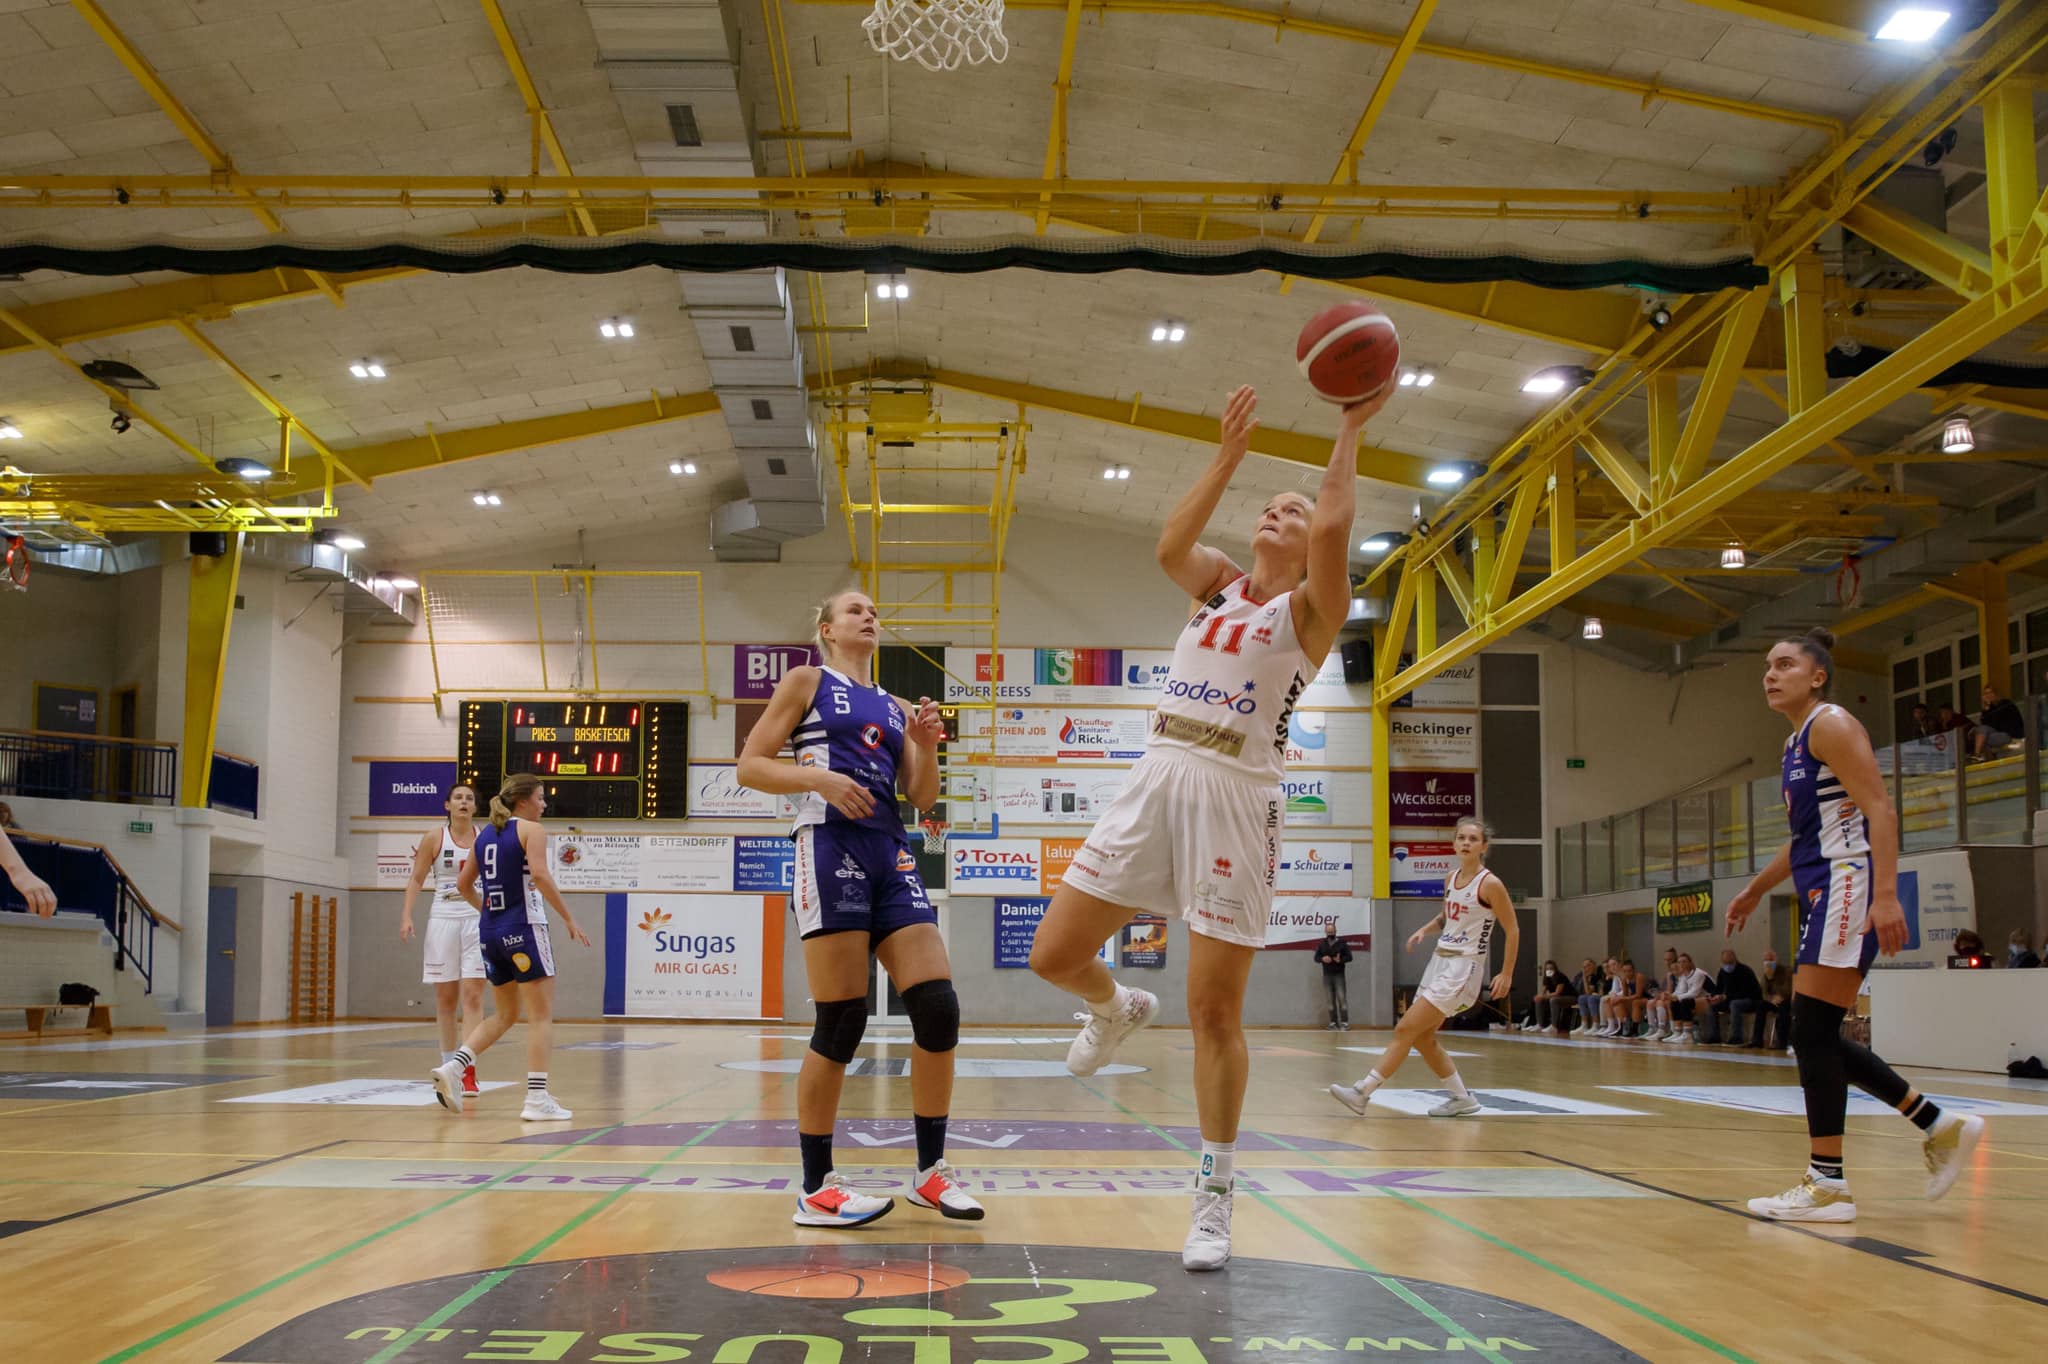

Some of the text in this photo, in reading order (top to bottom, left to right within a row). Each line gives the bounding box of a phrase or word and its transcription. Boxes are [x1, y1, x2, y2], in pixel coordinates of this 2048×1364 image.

[1197, 615, 1249, 656] 11
[949, 685, 1031, 698] SPUERKEESS
[1165, 680, 1256, 715] sodexo
[833, 692, 850, 714] 5
[1073, 718, 1113, 727] Chauffage
[1392, 721, 1473, 737] Reckinger
[531, 727, 631, 743] PIKES BASKETESCH
[1078, 735, 1103, 744] Rick
[392, 783, 438, 794] Diekirch
[1391, 791, 1472, 805] WECKBECKER
[650, 837, 728, 847] BETTENDORFF
[740, 840, 773, 848] WELTER
[774, 840, 780, 848] &
[484, 843, 498, 879] 9
[970, 849, 1038, 864] TOTAL
[1413, 861, 1450, 870] RE/MAX
[834, 867, 867, 880] ers
[964, 867, 1029, 878] LEAGUE
[1001, 903, 1045, 916] Daniel
[1837, 875, 1854, 947] RECKINGER
[1001, 919, 1023, 927] Agence
[1266, 911, 1340, 926] ile weber
[655, 930, 736, 959] Sungas
[655, 963, 681, 974] MIR
[685, 964, 698, 974] GI
[702, 964, 730, 975] GAS
